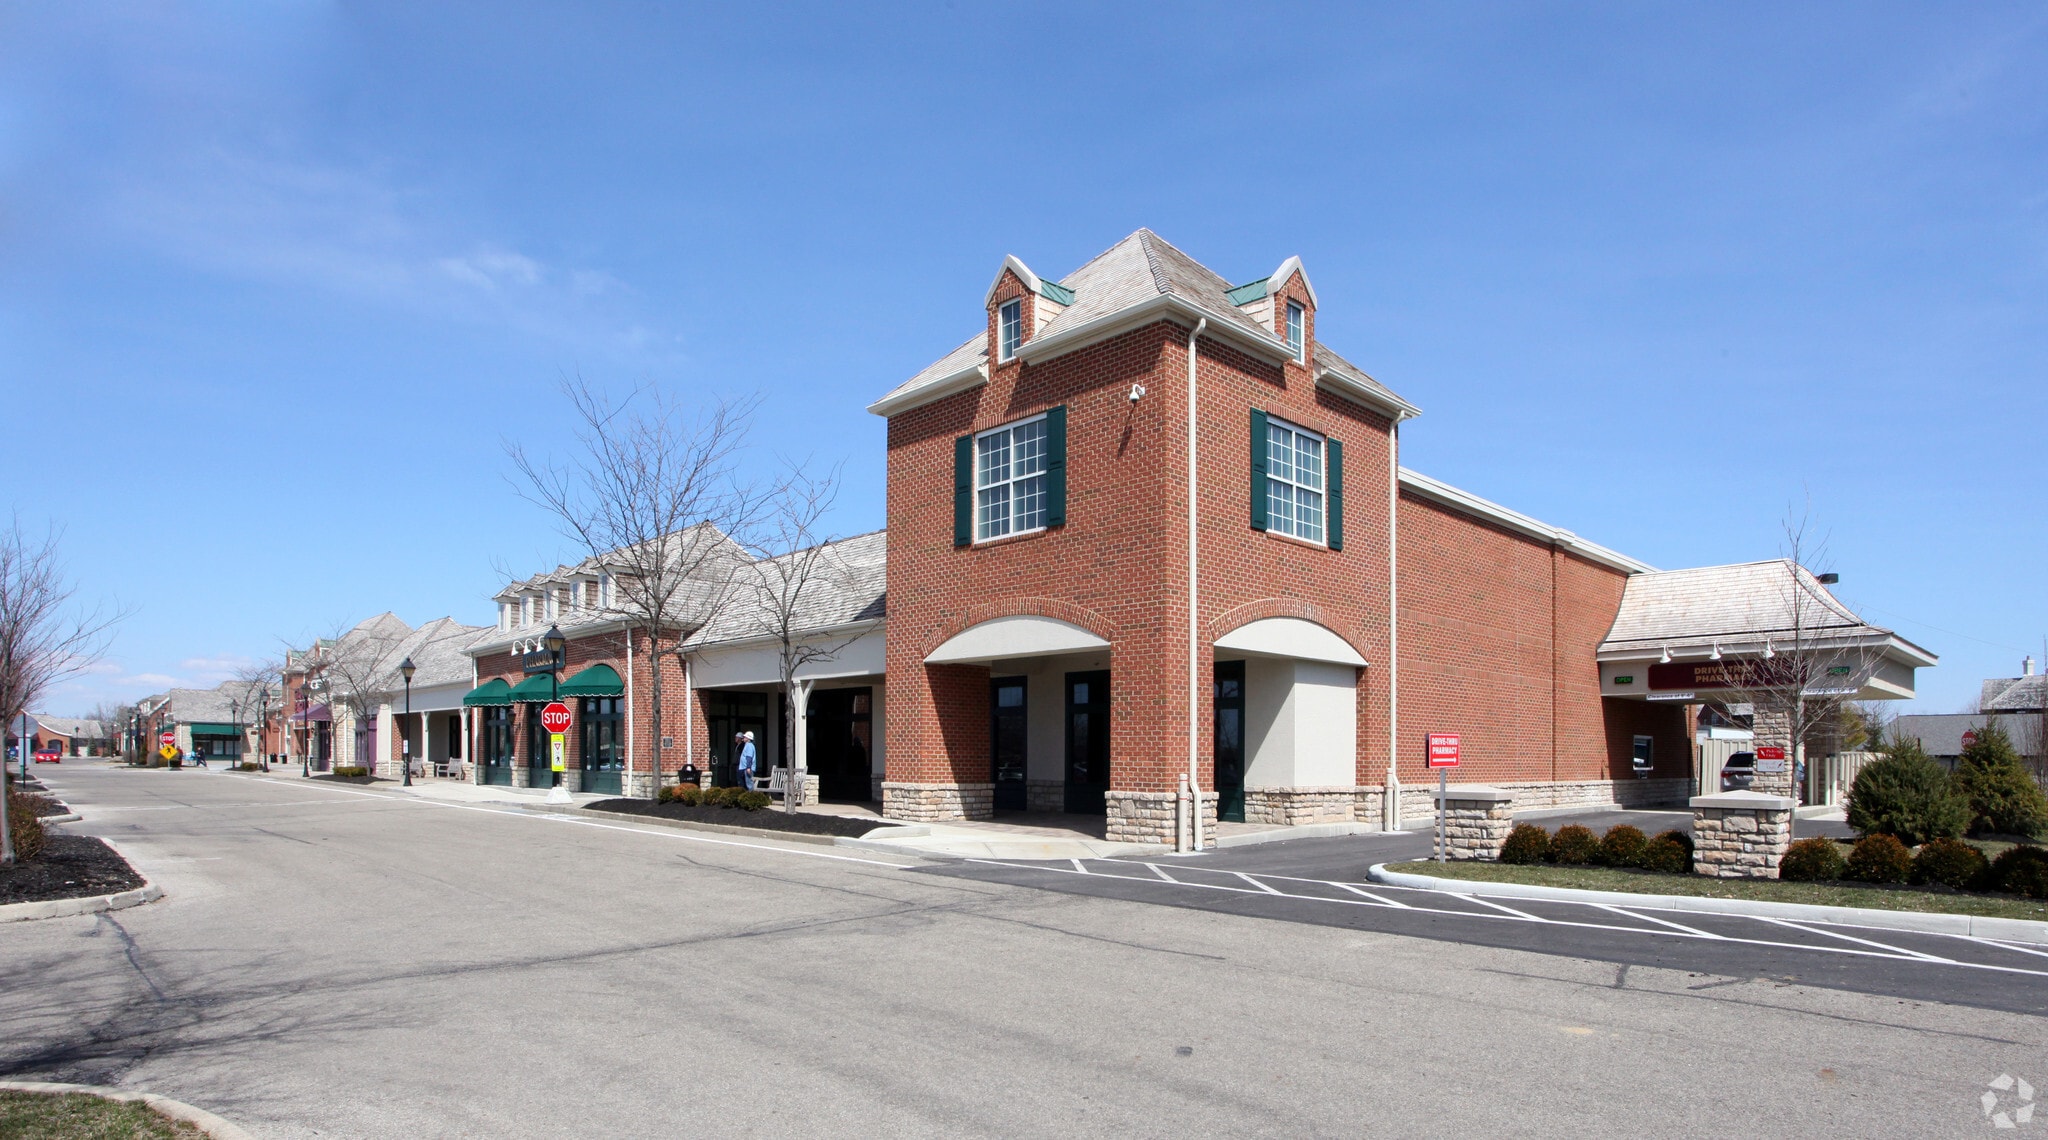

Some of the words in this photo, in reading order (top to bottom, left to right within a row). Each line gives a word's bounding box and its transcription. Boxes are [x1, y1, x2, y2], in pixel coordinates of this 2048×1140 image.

[544, 712, 570, 724] STOP
[1431, 737, 1458, 746] DRIVE-THRU
[1432, 746, 1457, 755] PHARMACY
